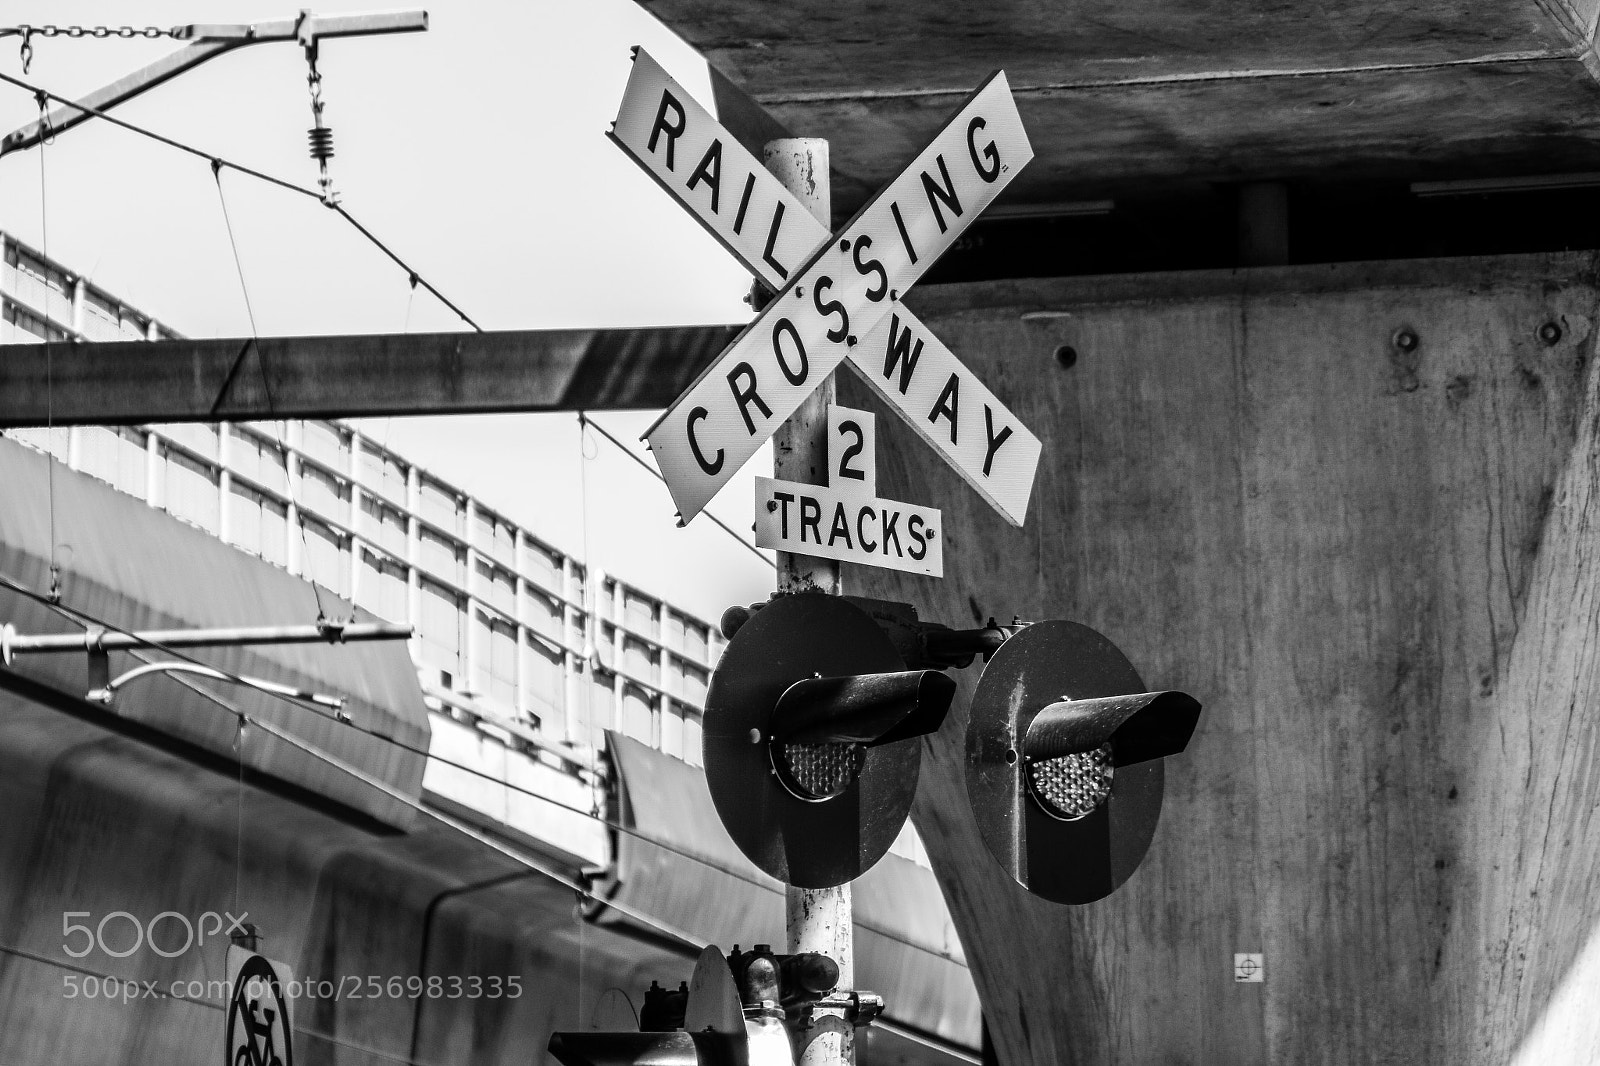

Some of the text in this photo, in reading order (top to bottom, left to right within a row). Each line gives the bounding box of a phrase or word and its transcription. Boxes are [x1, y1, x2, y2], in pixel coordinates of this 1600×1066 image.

[647, 88, 1013, 478] RAIL WAY
[686, 116, 1001, 476] CROSSING
[773, 491, 927, 561] TRACKS
[838, 420, 866, 481] 2
